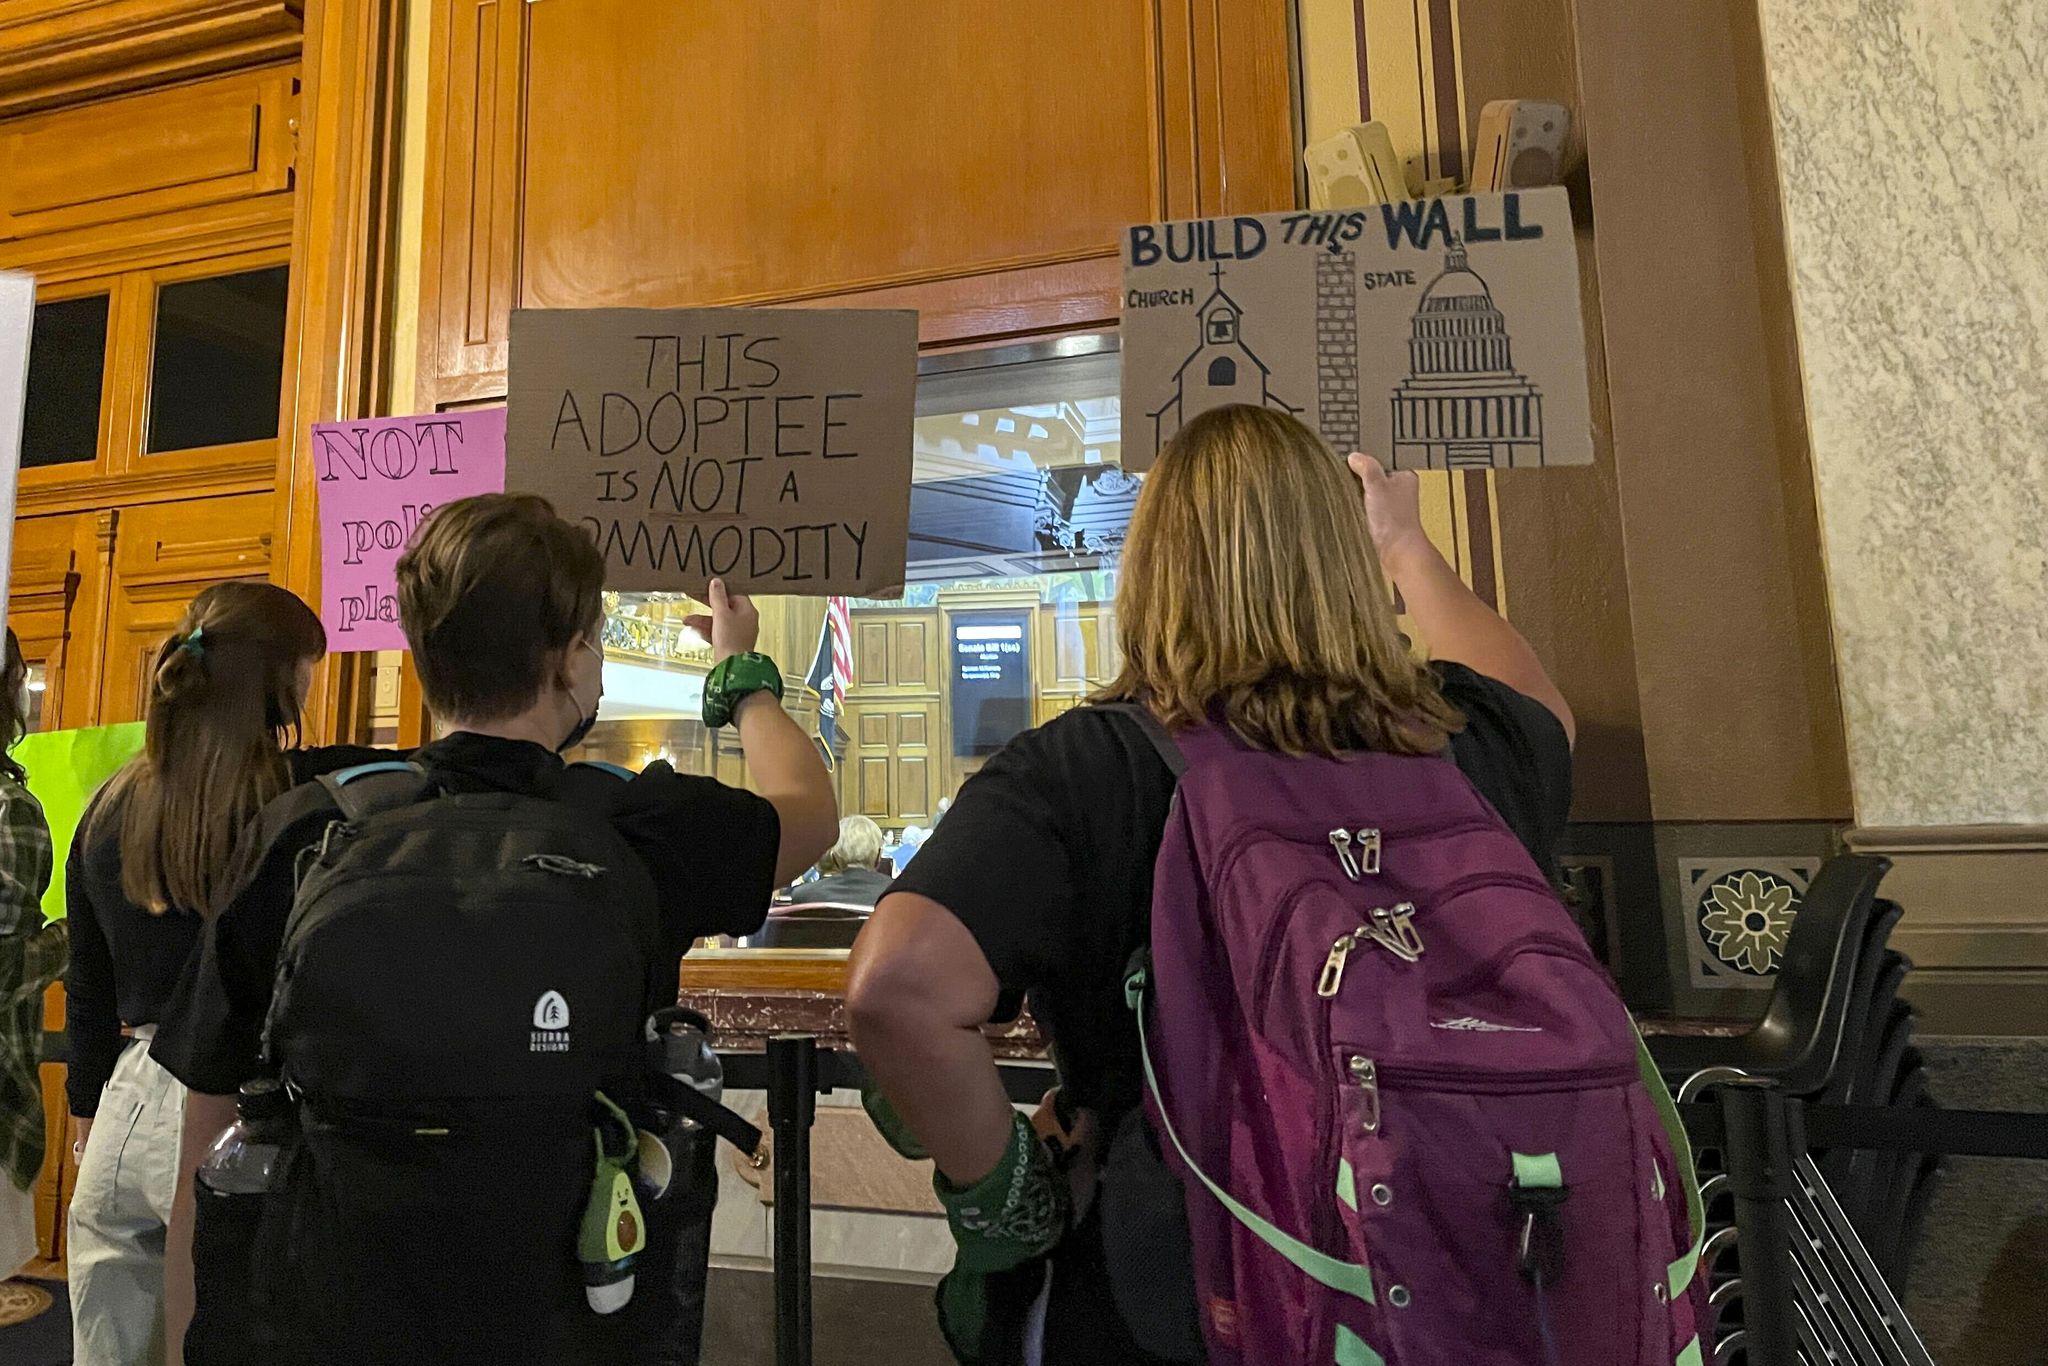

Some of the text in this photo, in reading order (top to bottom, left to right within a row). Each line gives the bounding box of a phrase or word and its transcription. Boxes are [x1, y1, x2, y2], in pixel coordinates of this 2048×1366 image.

[1130, 193, 1543, 267] BUILD THIS WALL
[1127, 288, 1194, 308] CHURCH
[1364, 270, 1417, 290] STATE
[635, 333, 780, 392] THIS
[316, 420, 464, 482] NOT
[550, 390, 863, 459] ADOPTEE
[595, 456, 799, 514] IS NOT A
[582, 516, 869, 581] MMODITY
